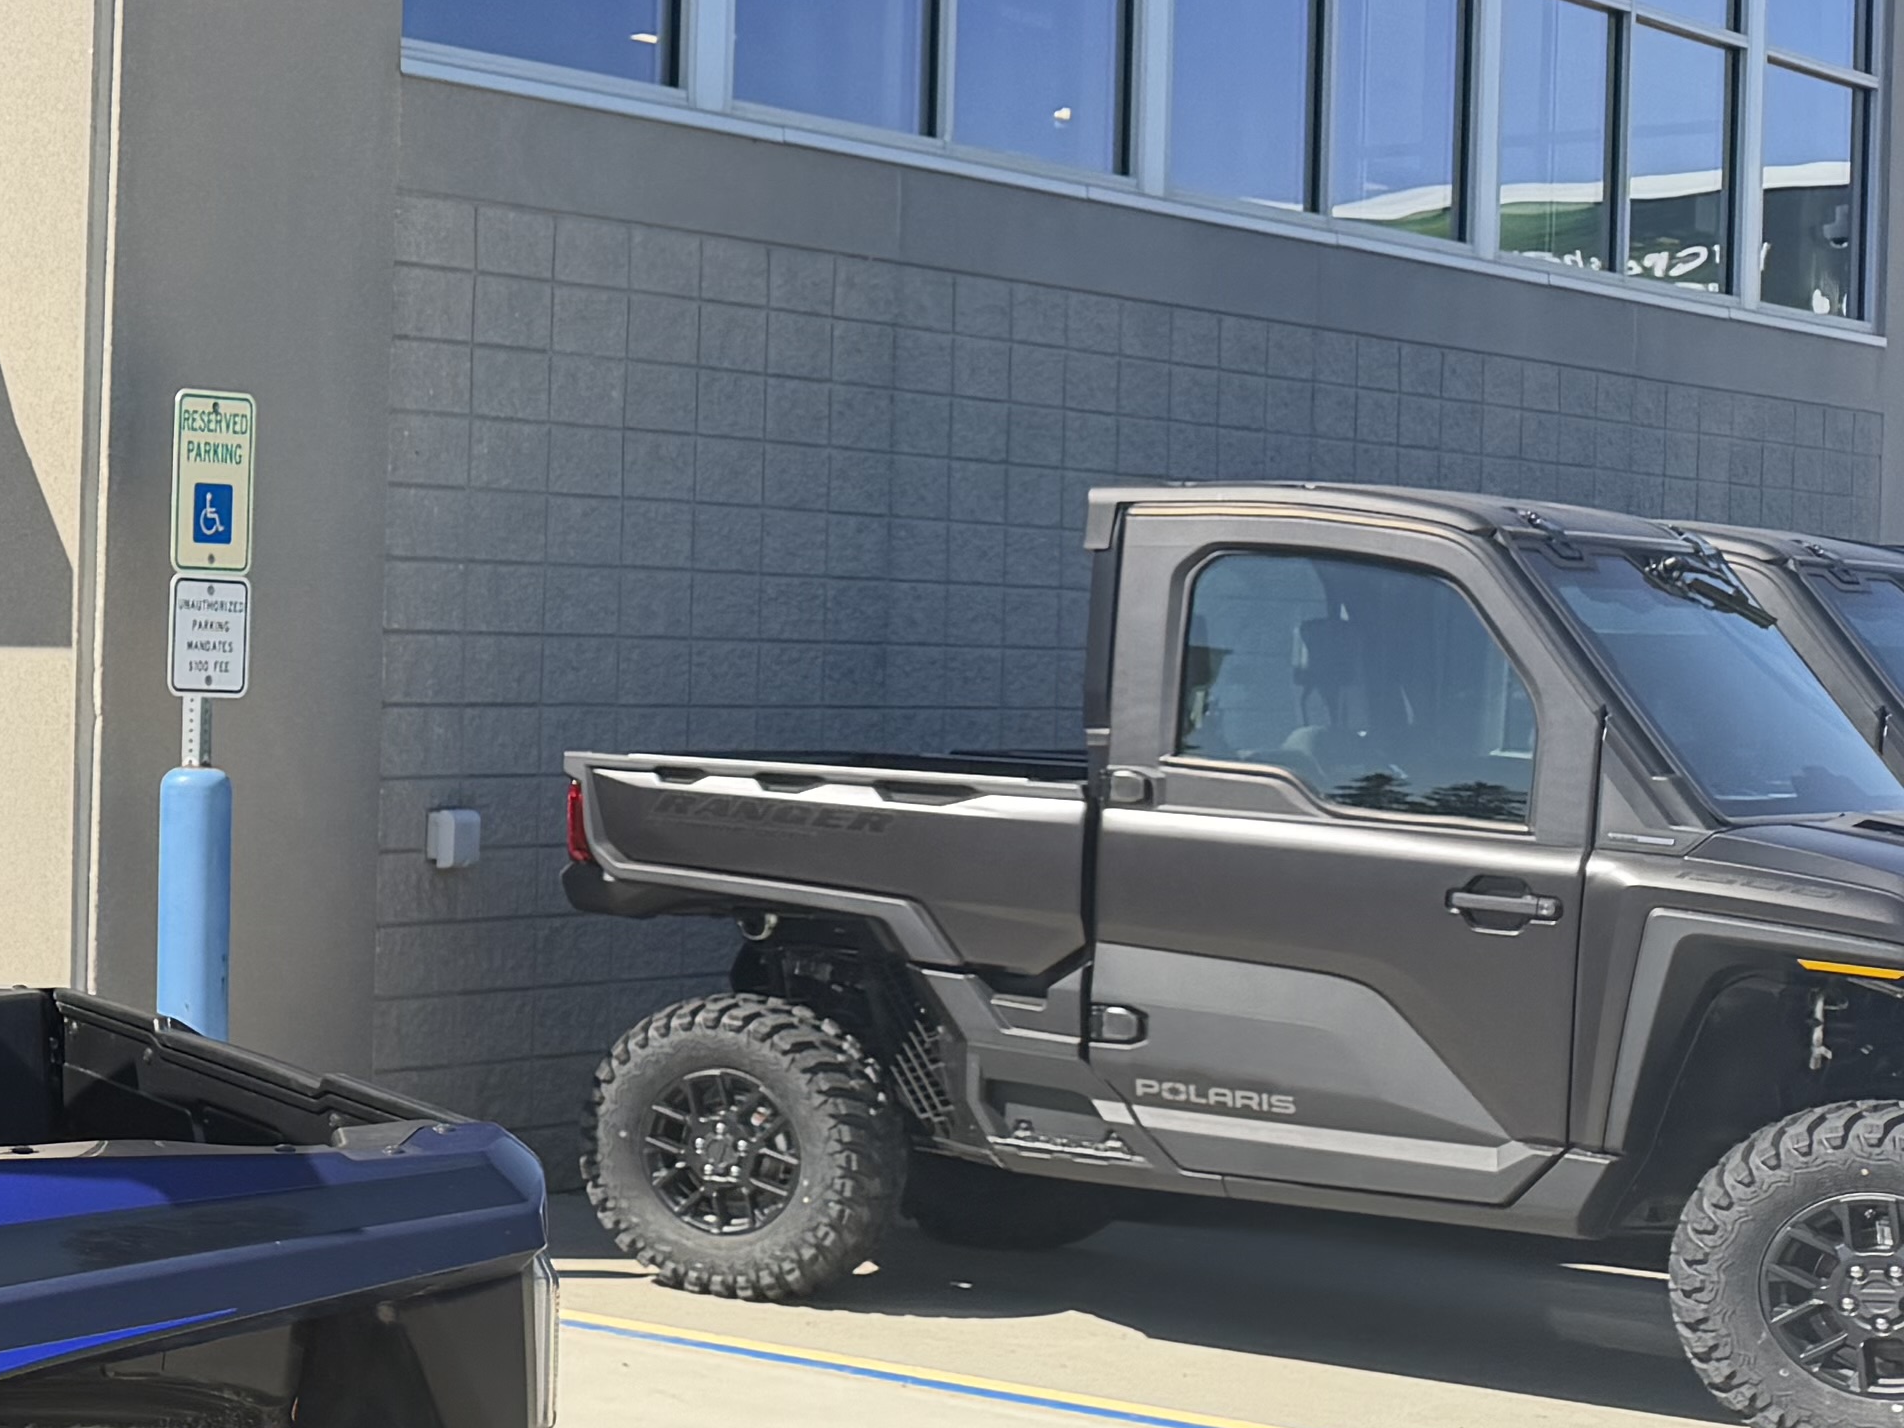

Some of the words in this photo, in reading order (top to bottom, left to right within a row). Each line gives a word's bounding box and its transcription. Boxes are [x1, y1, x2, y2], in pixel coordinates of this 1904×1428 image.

[181, 408, 249, 436] RESERVED
[186, 440, 243, 466] PARKING
[178, 598, 244, 614] UNAUTHORIZED
[191, 619, 231, 633] PARKING
[186, 639, 234, 654] MANDATES
[212, 660, 230, 674] FEE
[653, 793, 896, 834] RANGER
[1135, 1078, 1297, 1115] POLARIS
